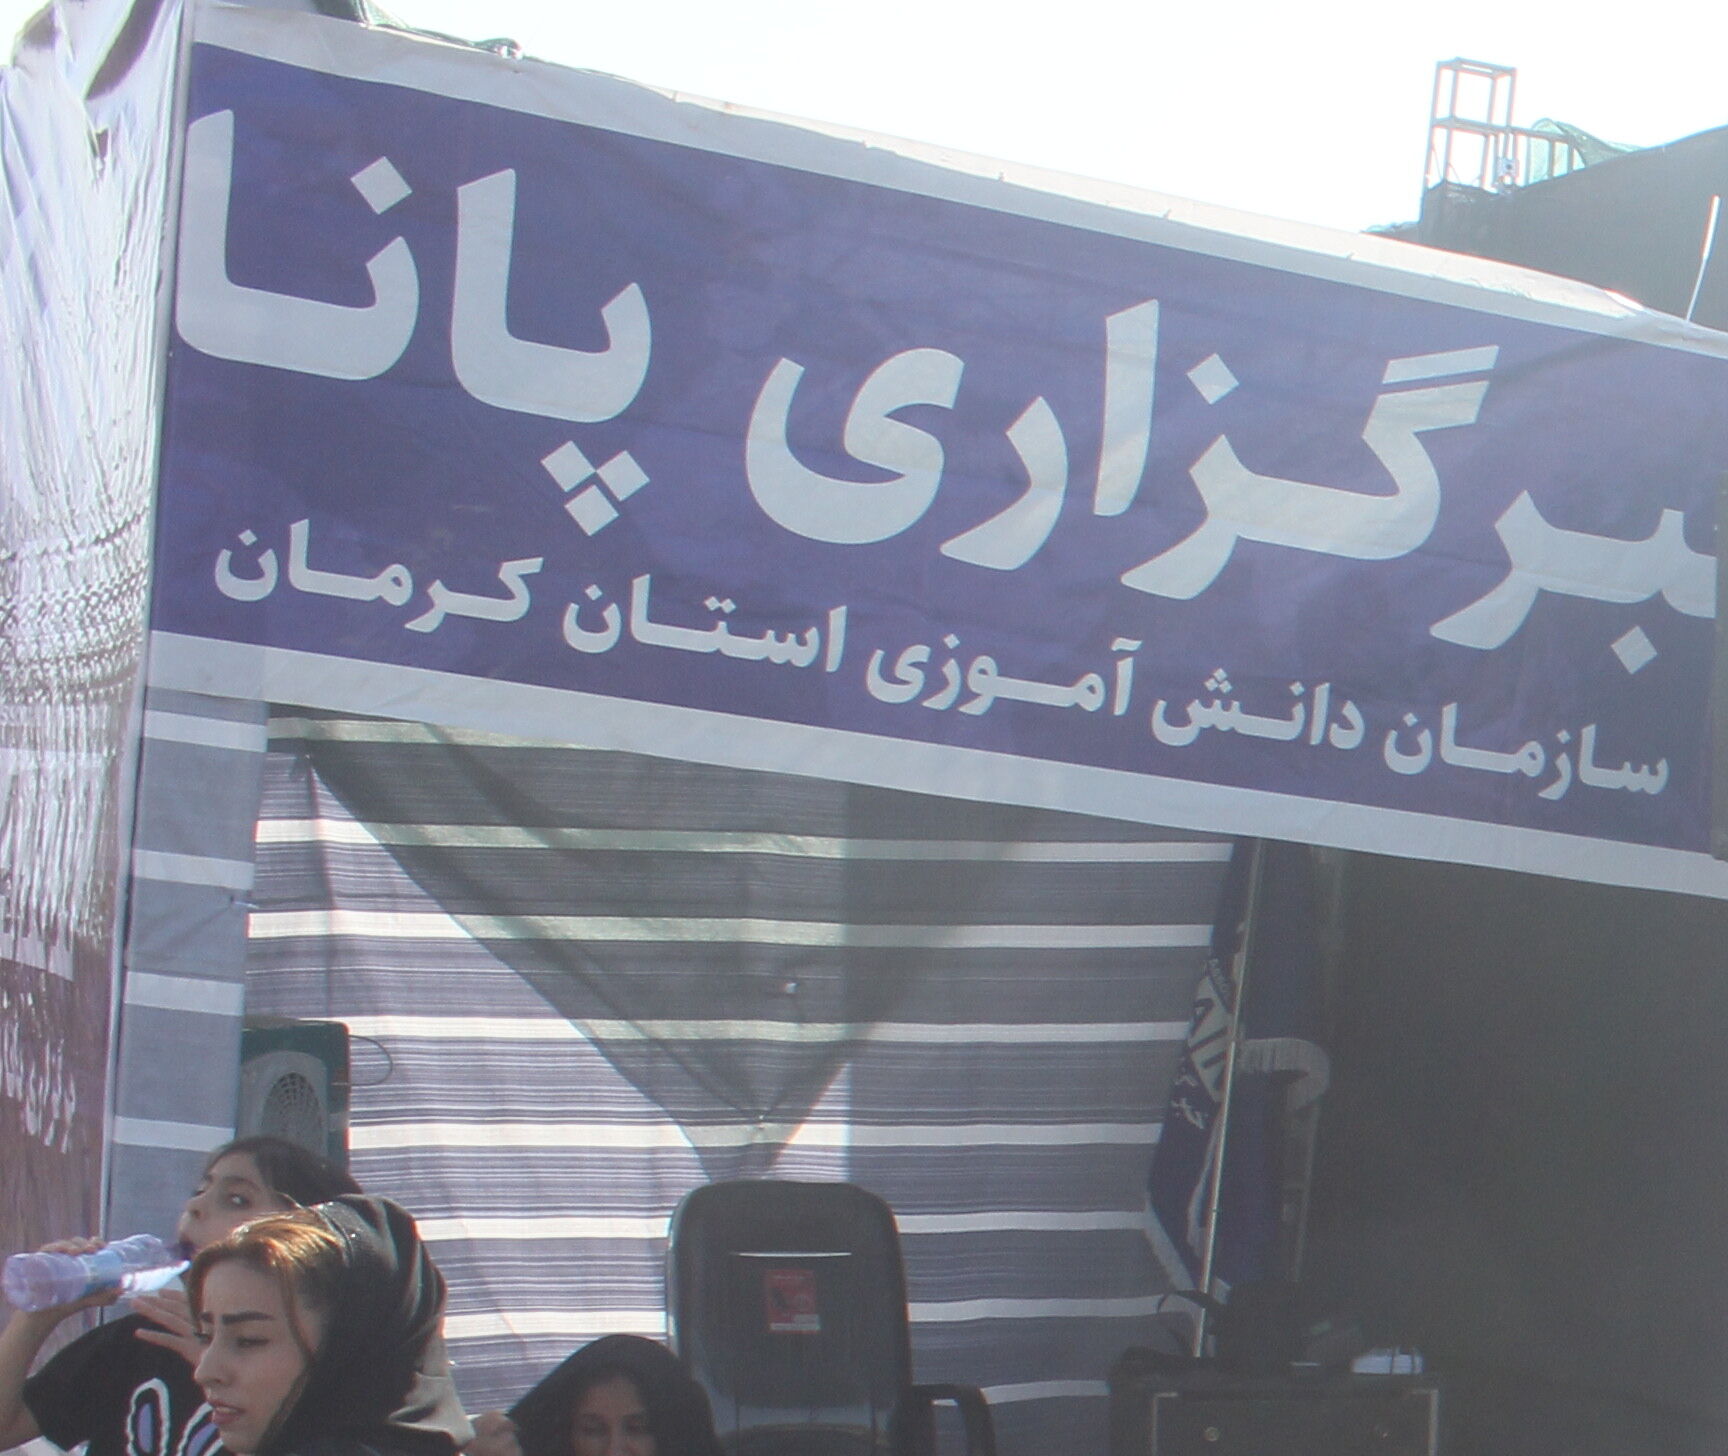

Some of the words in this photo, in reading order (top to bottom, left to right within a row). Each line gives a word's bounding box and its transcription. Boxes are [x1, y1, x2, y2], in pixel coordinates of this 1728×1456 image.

[175, 109, 653, 536] پانا
[214, 519, 543, 632] کرمان
[562, 573, 848, 673] استان
[866, 637, 1142, 717] آموزی
[1151, 667, 1365, 750] دانش
[1383, 702, 1670, 800] سازمان
